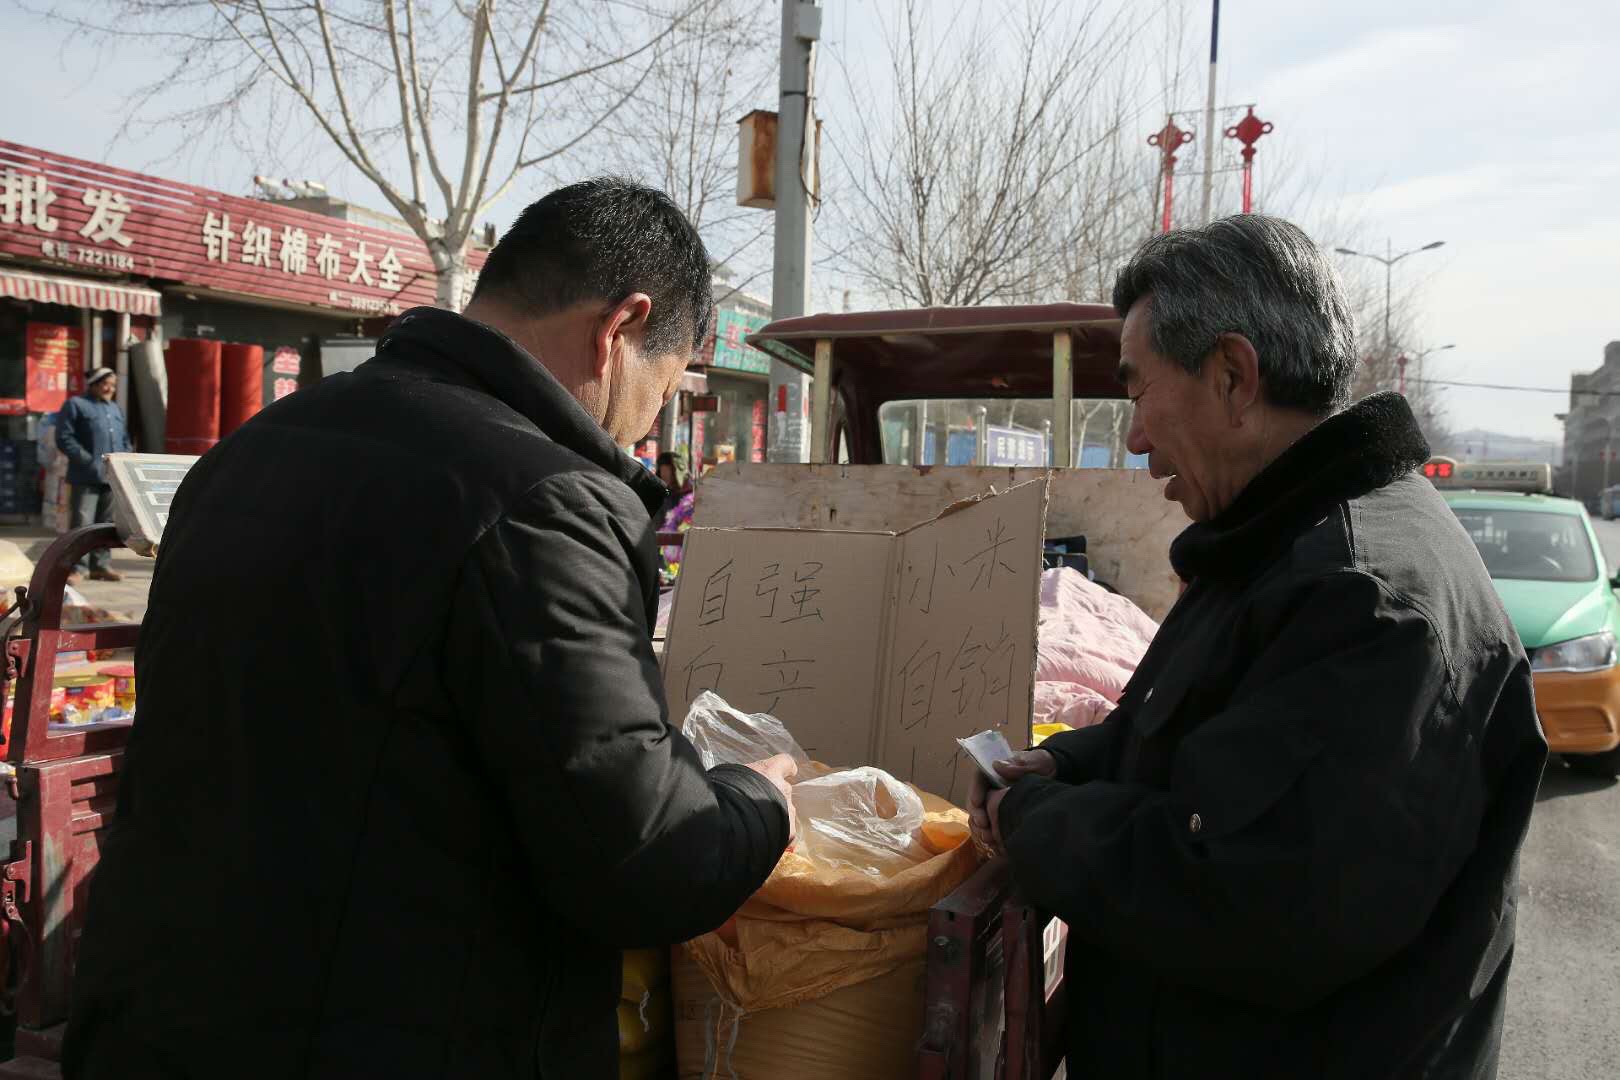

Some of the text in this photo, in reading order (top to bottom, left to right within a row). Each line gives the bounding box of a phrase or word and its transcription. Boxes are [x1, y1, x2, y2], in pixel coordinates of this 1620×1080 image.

[0, 168, 134, 248] 批发
[202, 211, 403, 291] 针织棉布大全
